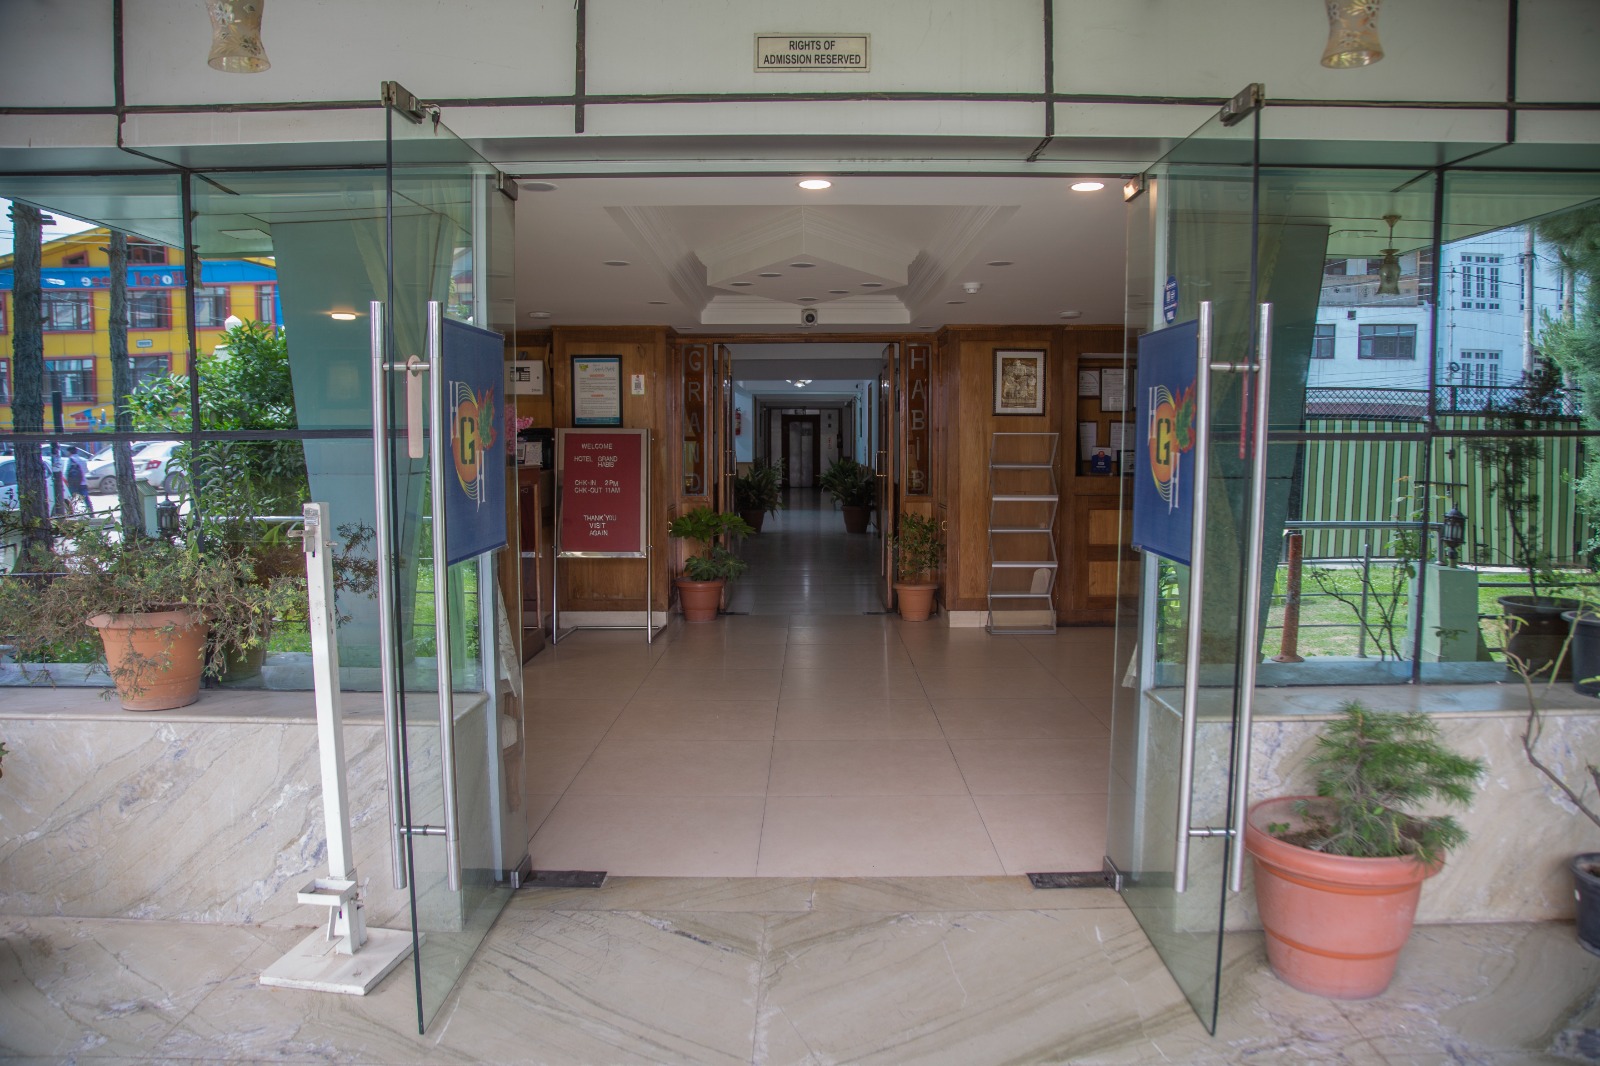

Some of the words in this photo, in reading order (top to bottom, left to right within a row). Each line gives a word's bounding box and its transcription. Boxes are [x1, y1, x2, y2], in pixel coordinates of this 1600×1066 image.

[789, 40, 821, 50] RIGHTS
[823, 40, 835, 50] OF
[763, 54, 812, 65] ADMISSION
[814, 54, 861, 65] RESERVED
[688, 350, 702, 492] GRAND
